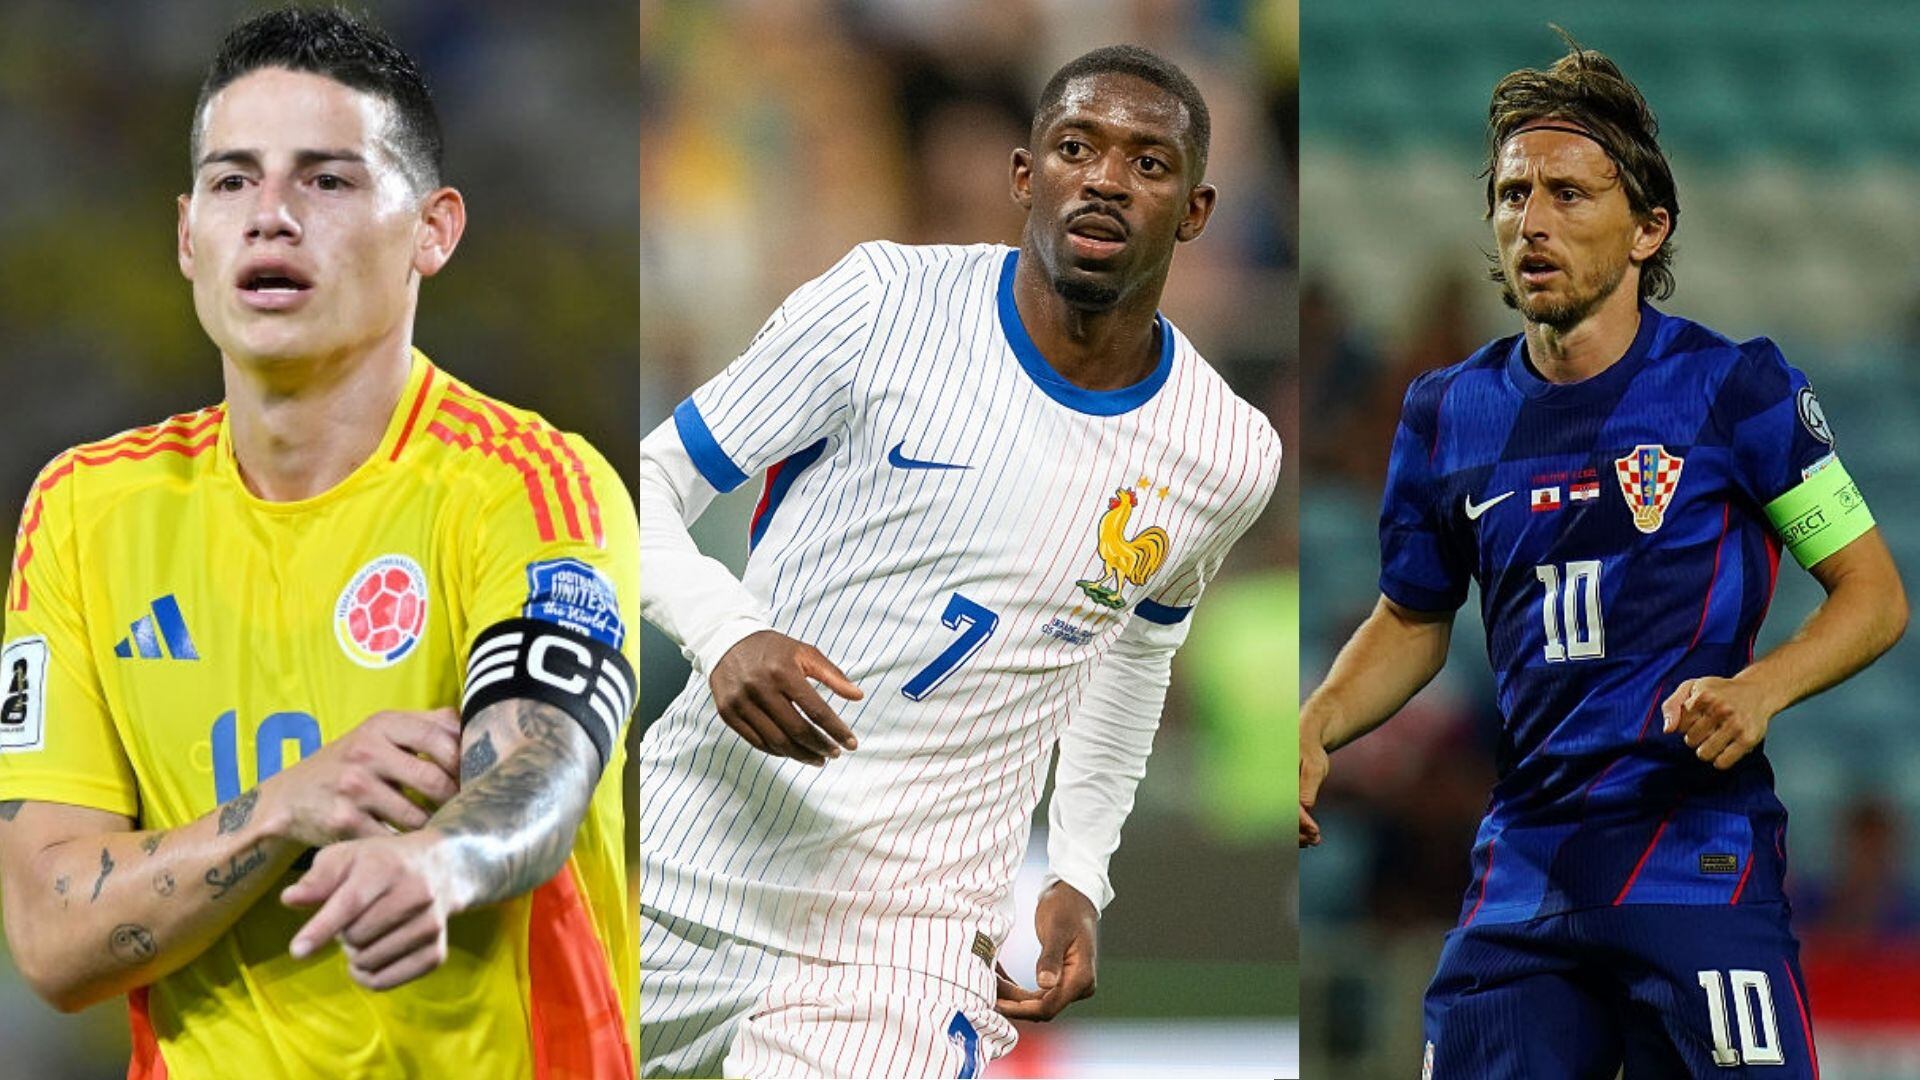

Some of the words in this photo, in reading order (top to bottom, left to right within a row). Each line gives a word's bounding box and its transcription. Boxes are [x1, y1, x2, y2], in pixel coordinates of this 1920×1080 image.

[1783, 509, 1825, 541] SPECT
[901, 592, 999, 702] 7
[1536, 560, 1605, 662] 10
[526, 634, 592, 695] C
[1697, 969, 1785, 1067] 10
